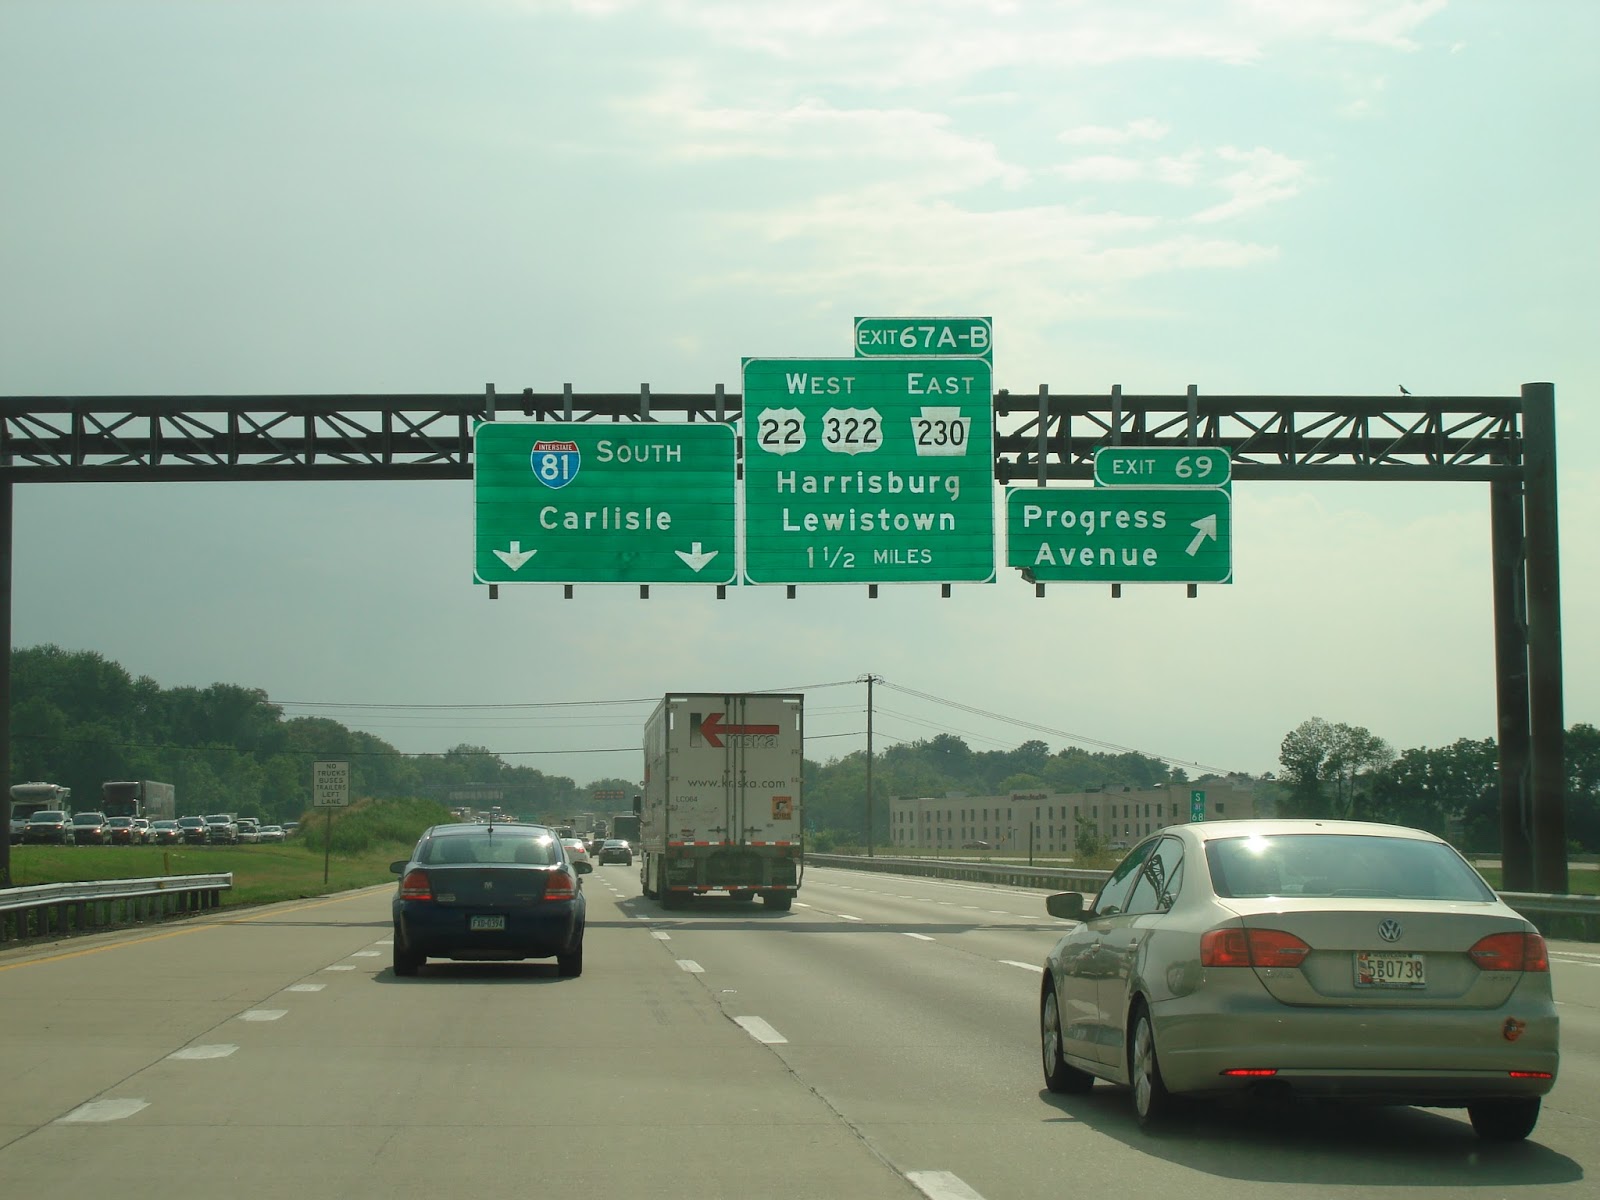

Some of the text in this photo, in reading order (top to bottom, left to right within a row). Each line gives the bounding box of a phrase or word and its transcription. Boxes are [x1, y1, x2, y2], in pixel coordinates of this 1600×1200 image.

[858, 326, 988, 348] EXIT 67A-B
[785, 372, 856, 395] WEST
[907, 372, 975, 395] EAST
[761, 418, 801, 445] 22
[826, 417, 877, 444] 322
[917, 419, 965, 446] 230
[538, 443, 573, 451] INTERSTATE
[596, 440, 681, 463] SOUTH
[541, 453, 569, 480] 81
[1112, 455, 1213, 478] EXIT 69
[777, 471, 960, 501] Harrisburg
[539, 506, 672, 530] Carlisle
[783, 508, 956, 531] Lewistown
[1023, 505, 1167, 536] Progress
[873, 549, 932, 564] MILES
[1034, 542, 1158, 566] Avenue
[687, 775, 786, 788] www.krska.com
[1195, 792, 1201, 802] S
[1191, 813, 1204, 821] 68
